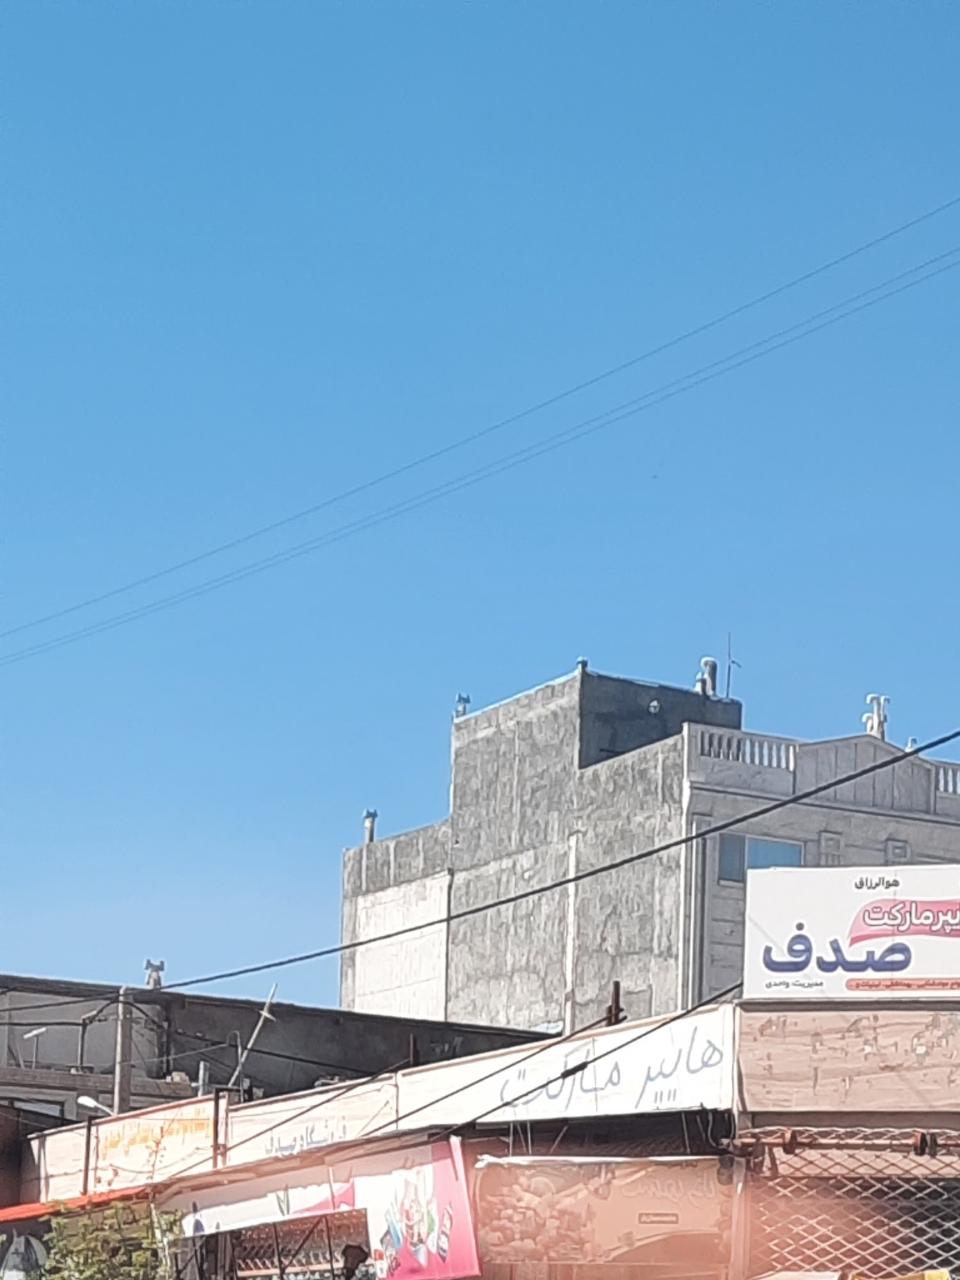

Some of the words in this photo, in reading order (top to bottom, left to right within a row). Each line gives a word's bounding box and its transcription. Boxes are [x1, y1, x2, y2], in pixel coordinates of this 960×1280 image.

[855, 877, 900, 890] هوالرزاق
[762, 922, 913, 973] صدف
[499, 1038, 621, 1113] مارکت
[634, 1026, 724, 1110] هایپر
